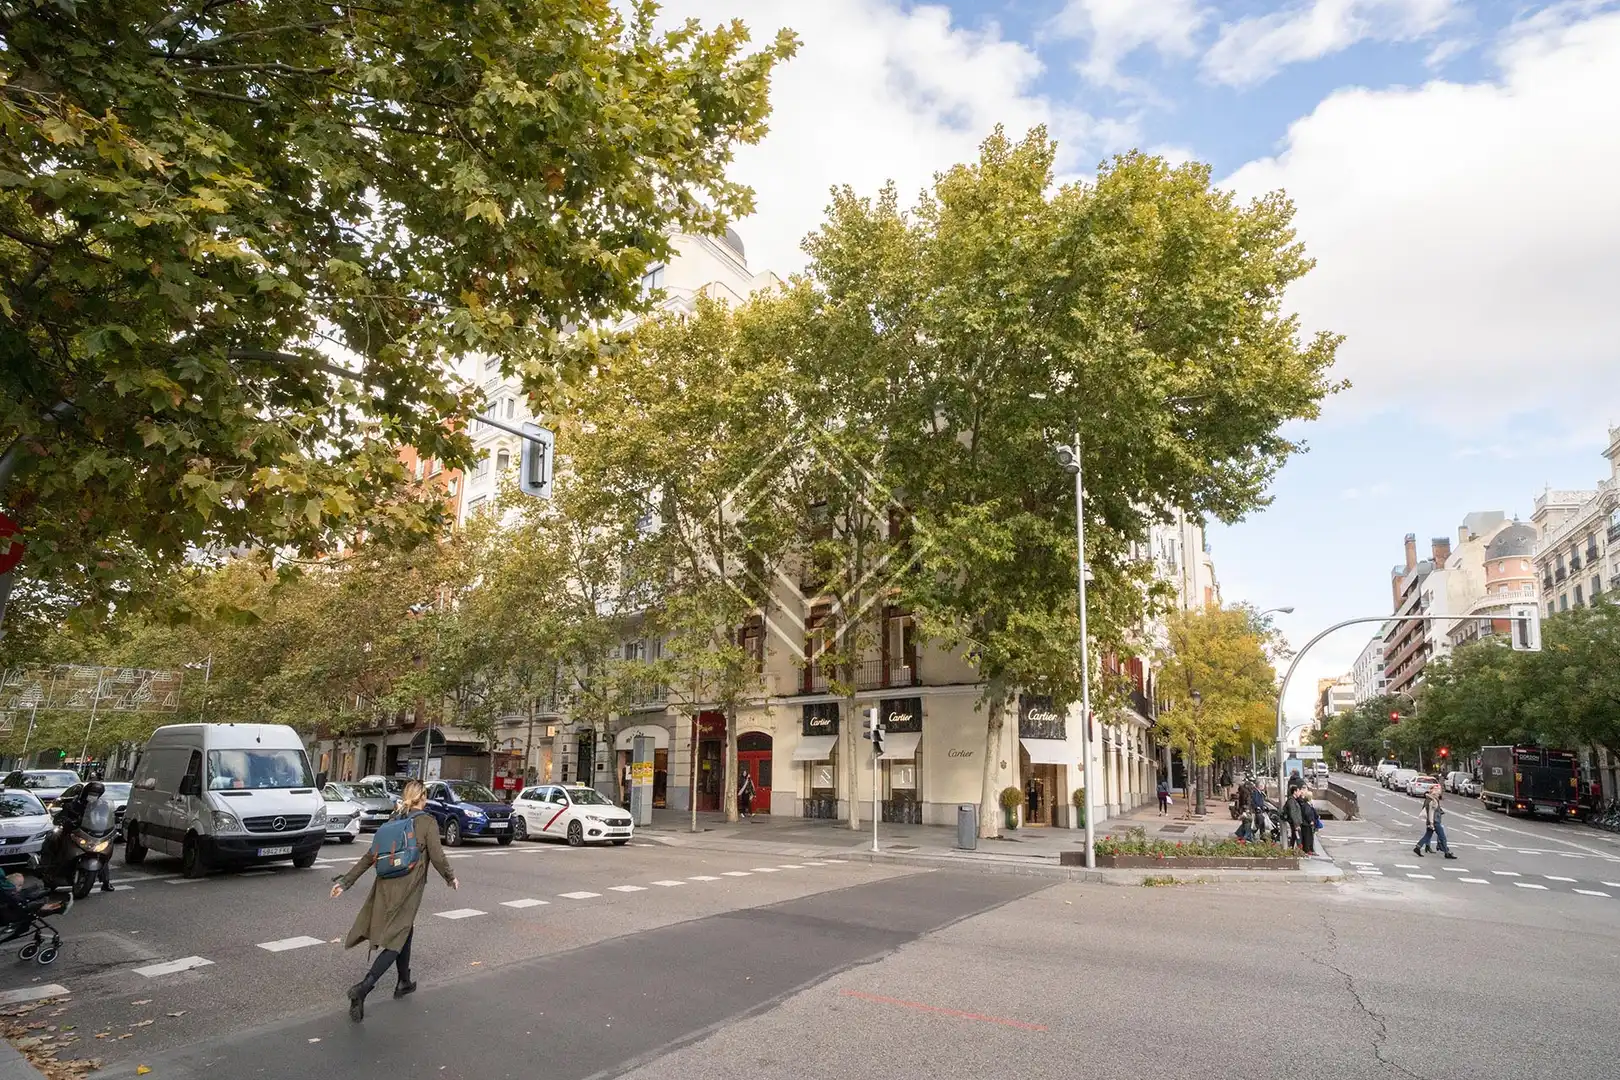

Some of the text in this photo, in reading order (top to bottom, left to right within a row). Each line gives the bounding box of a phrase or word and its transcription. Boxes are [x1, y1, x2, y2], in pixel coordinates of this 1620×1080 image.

[889, 711, 912, 721] Cartier
[1028, 708, 1057, 721] Cartier
[810, 716, 831, 726] Cartier
[947, 748, 974, 757] Cartier
